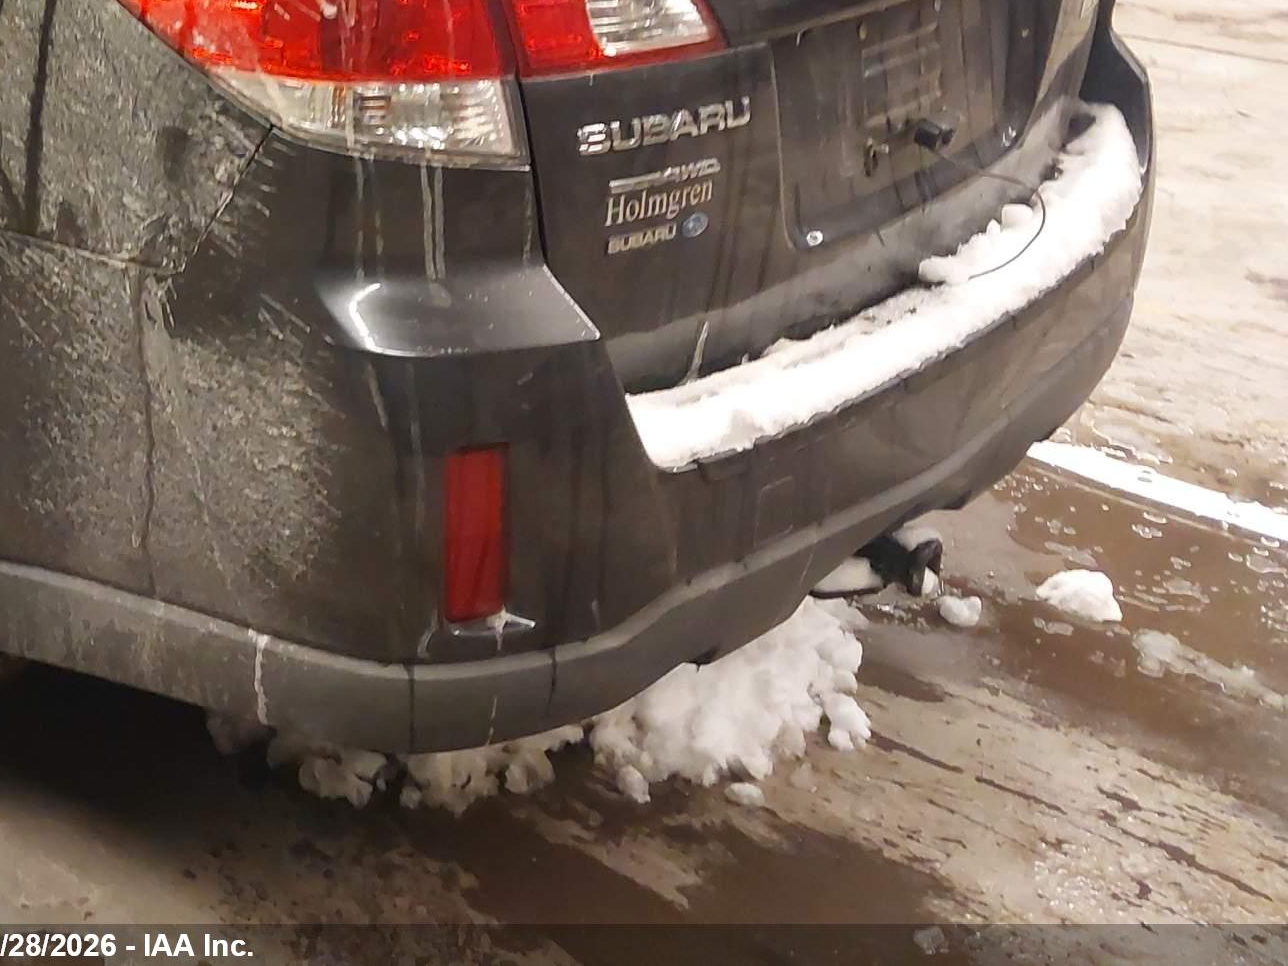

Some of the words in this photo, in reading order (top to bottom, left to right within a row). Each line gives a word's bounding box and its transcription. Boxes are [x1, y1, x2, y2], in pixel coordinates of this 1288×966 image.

[577, 95, 751, 156] SUBARU
[604, 179, 713, 227] Holmgren
[607, 222, 678, 254] SUBARU
